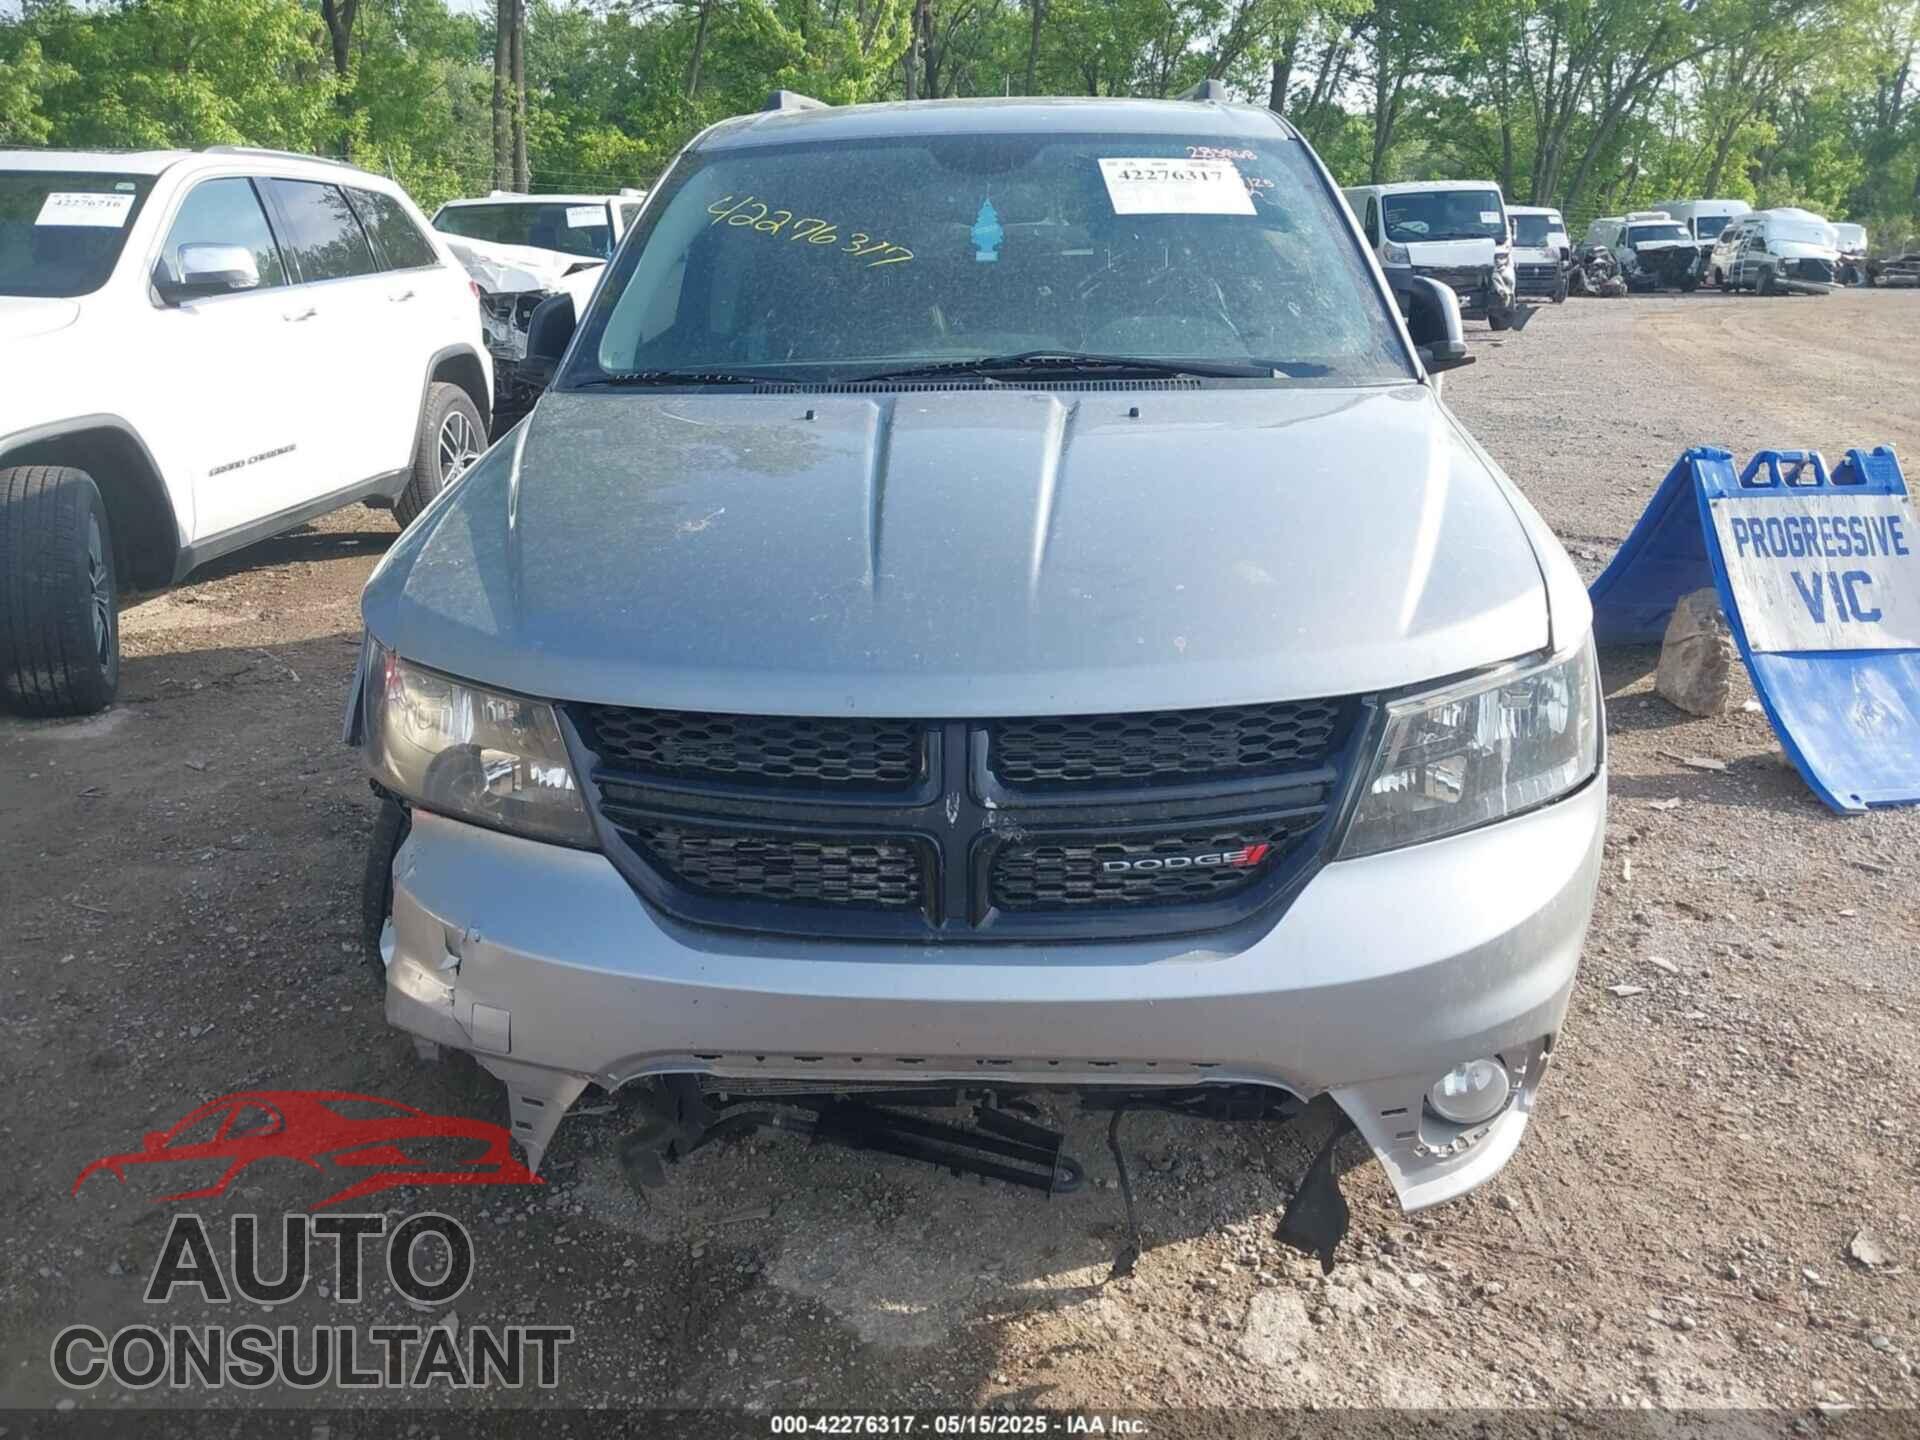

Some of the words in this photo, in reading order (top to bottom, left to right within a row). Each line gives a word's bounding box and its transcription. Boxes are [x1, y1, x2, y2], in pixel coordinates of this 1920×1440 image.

[1118, 169, 1222, 182] 42276317
[1731, 515, 1909, 557] PROGRESSIVE
[1790, 570, 1882, 623] VIC
[1103, 850, 1249, 872] DODGE
